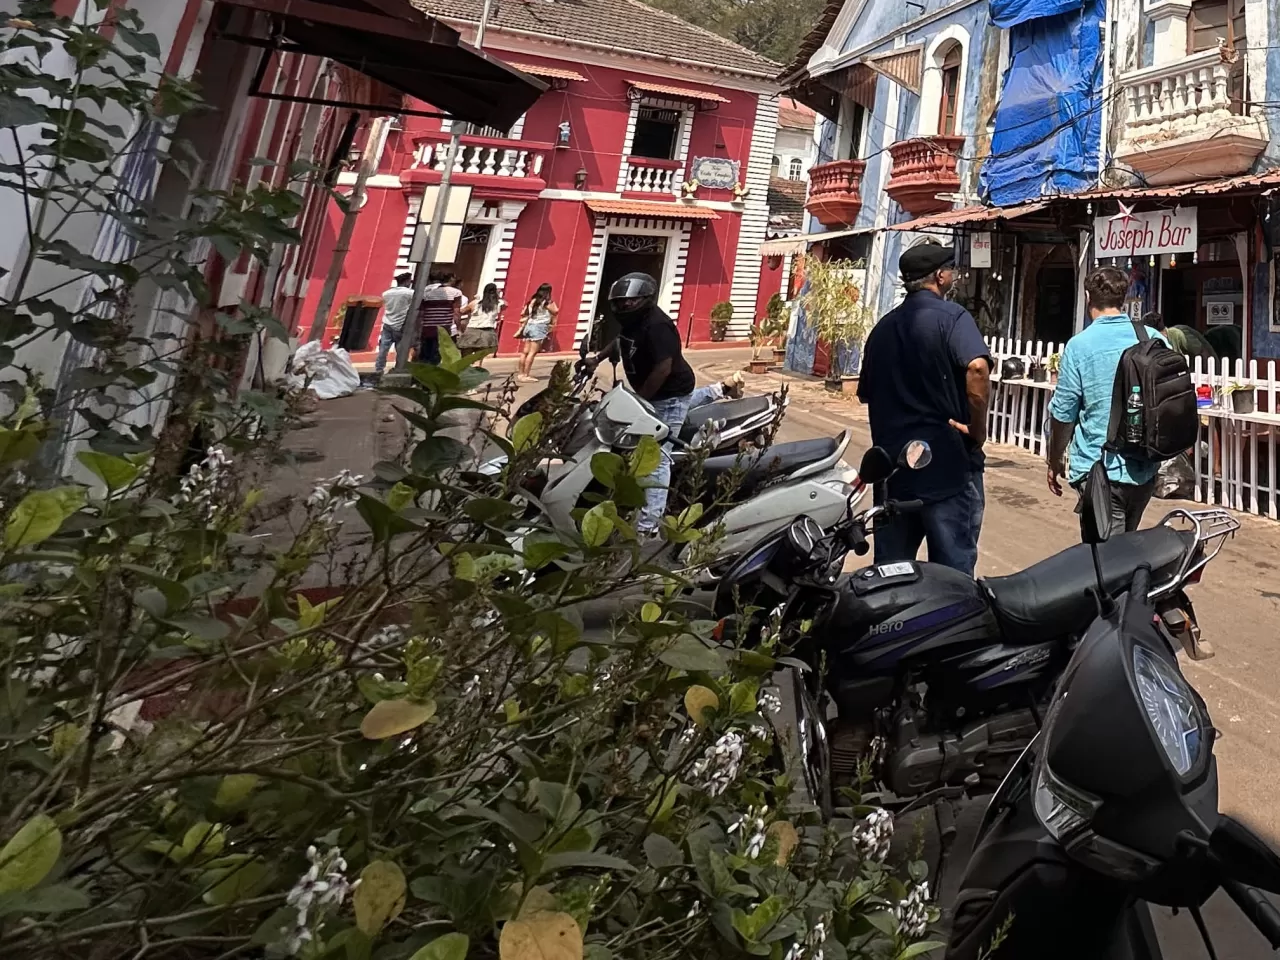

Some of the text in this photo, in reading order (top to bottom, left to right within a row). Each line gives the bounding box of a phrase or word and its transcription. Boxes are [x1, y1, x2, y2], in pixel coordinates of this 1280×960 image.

[1100, 214, 1191, 256] Joseph Bar
[869, 621, 904, 636] Hero
